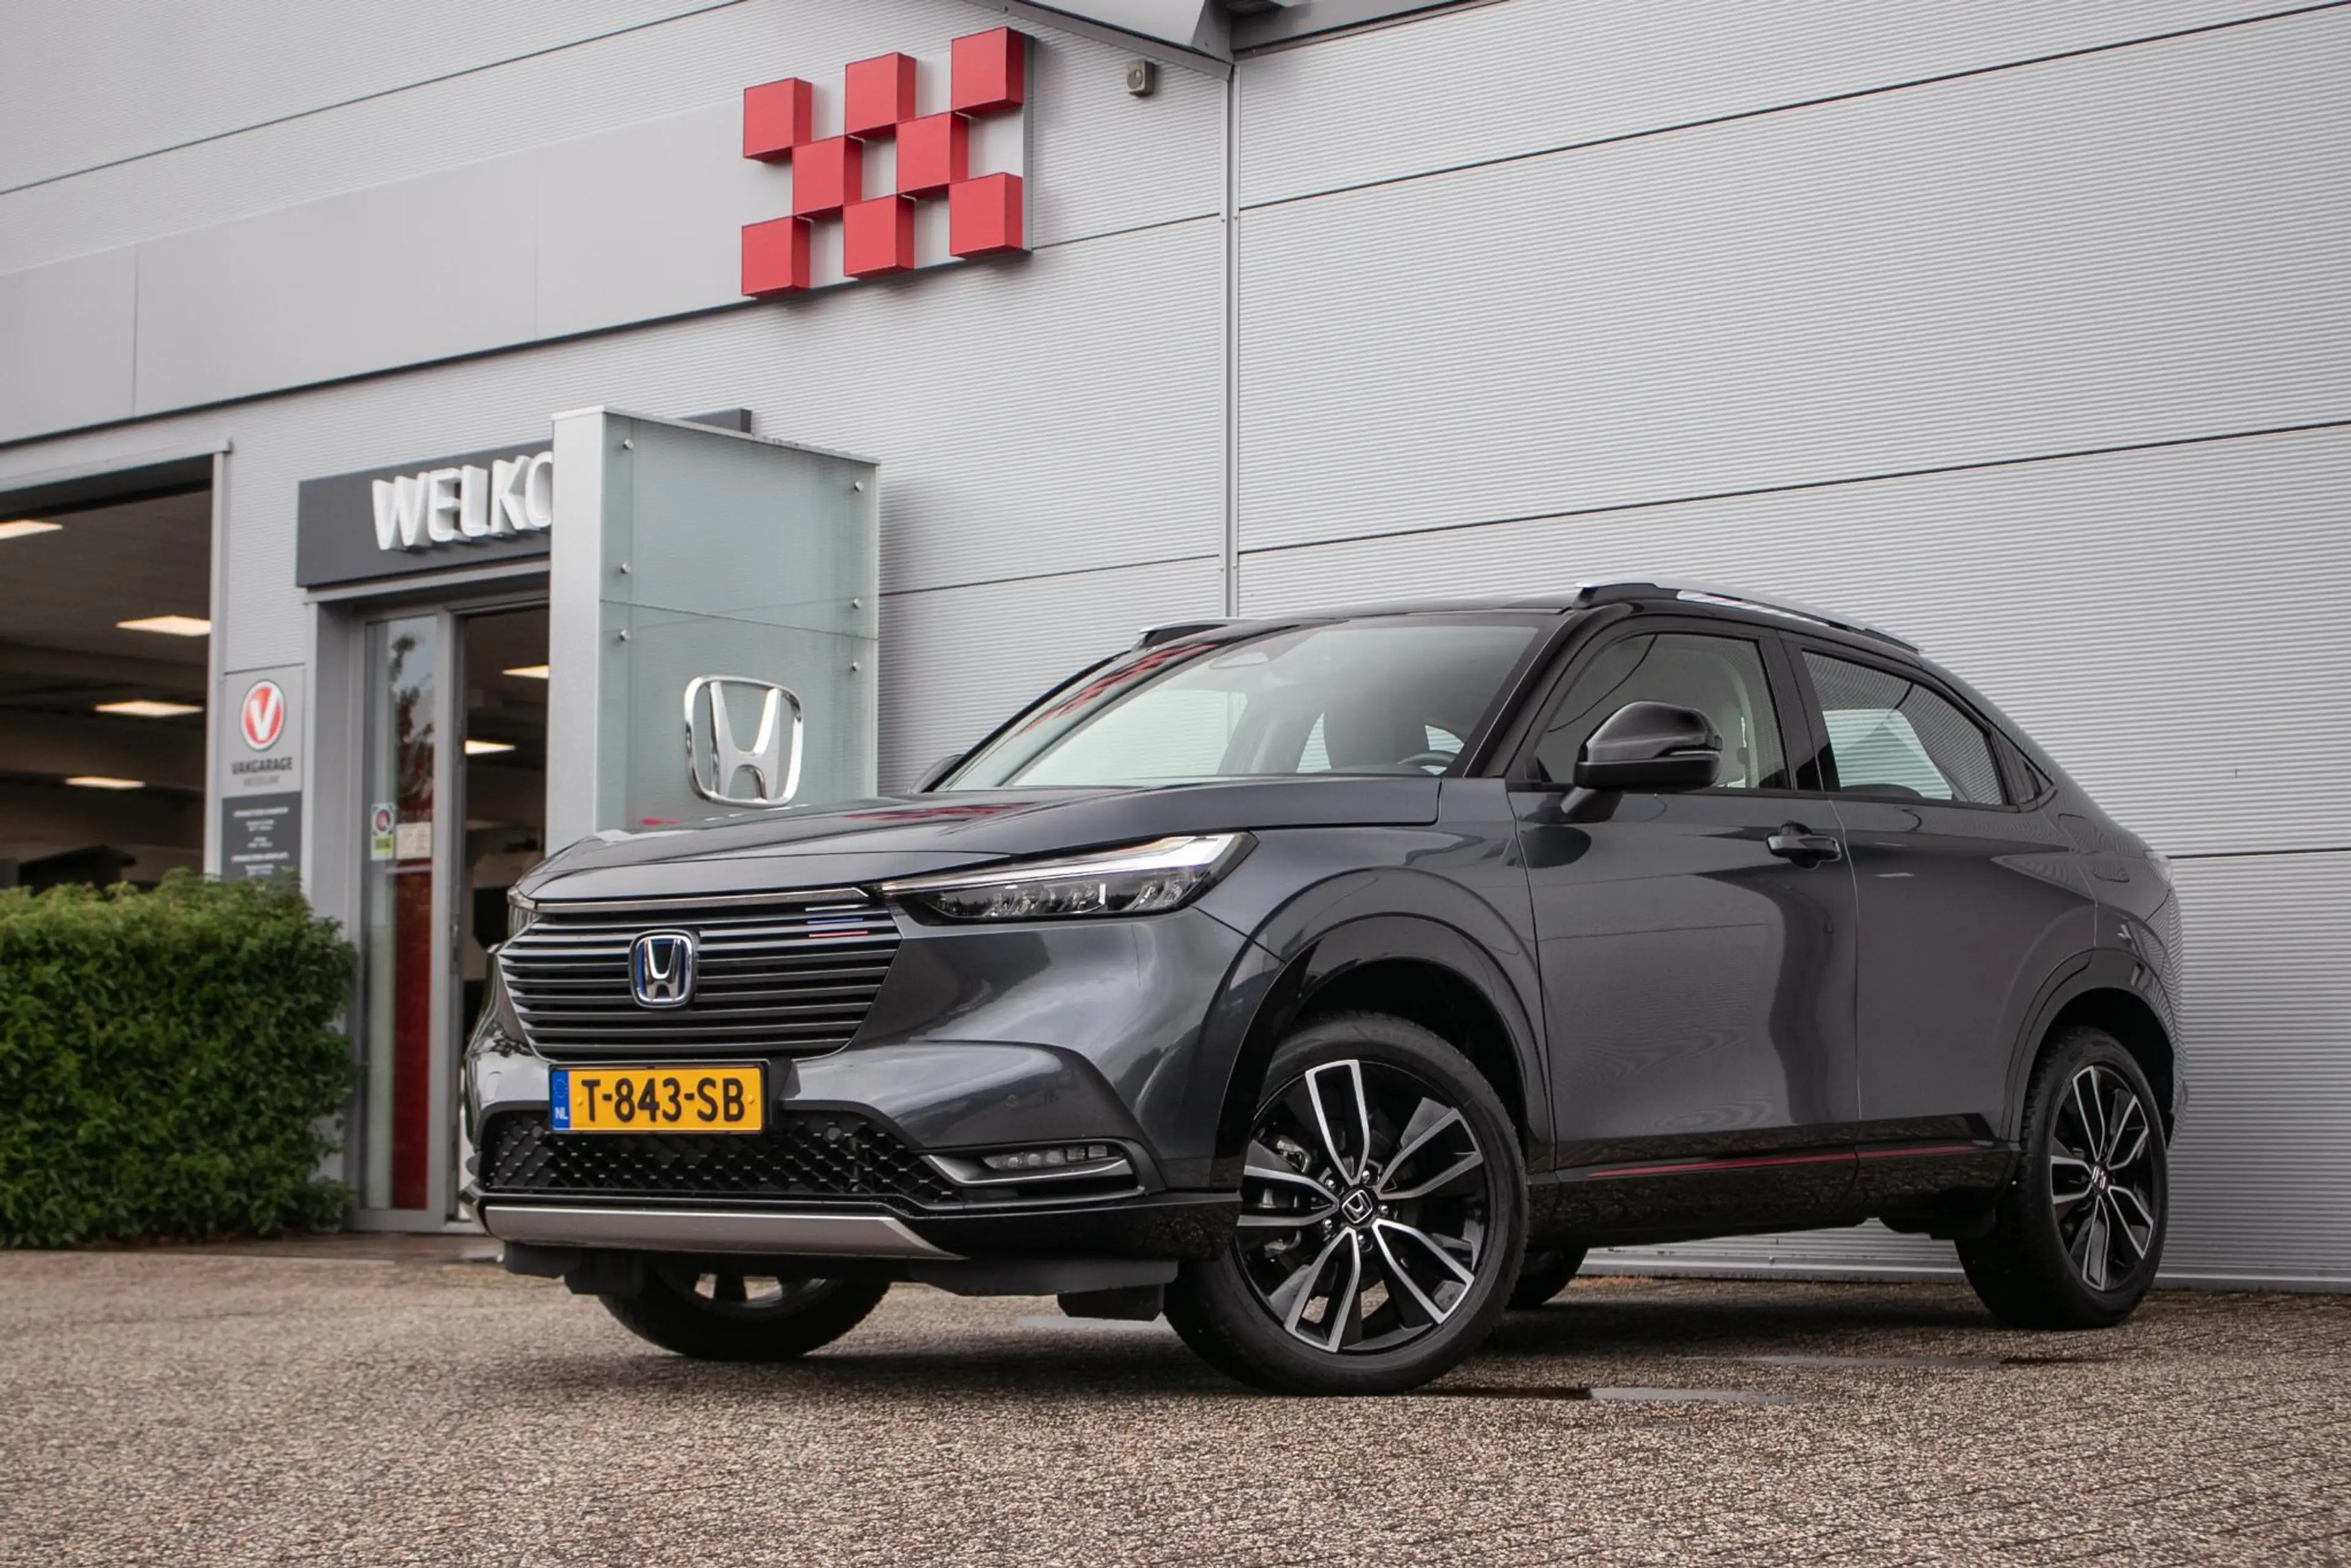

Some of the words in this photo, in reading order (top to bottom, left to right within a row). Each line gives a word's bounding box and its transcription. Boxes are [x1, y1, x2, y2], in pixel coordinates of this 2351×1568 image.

[231, 757, 293, 775] VAKGARAGE
[581, 1078, 745, 1122] T-843-SB
[555, 1106, 569, 1120] NL
